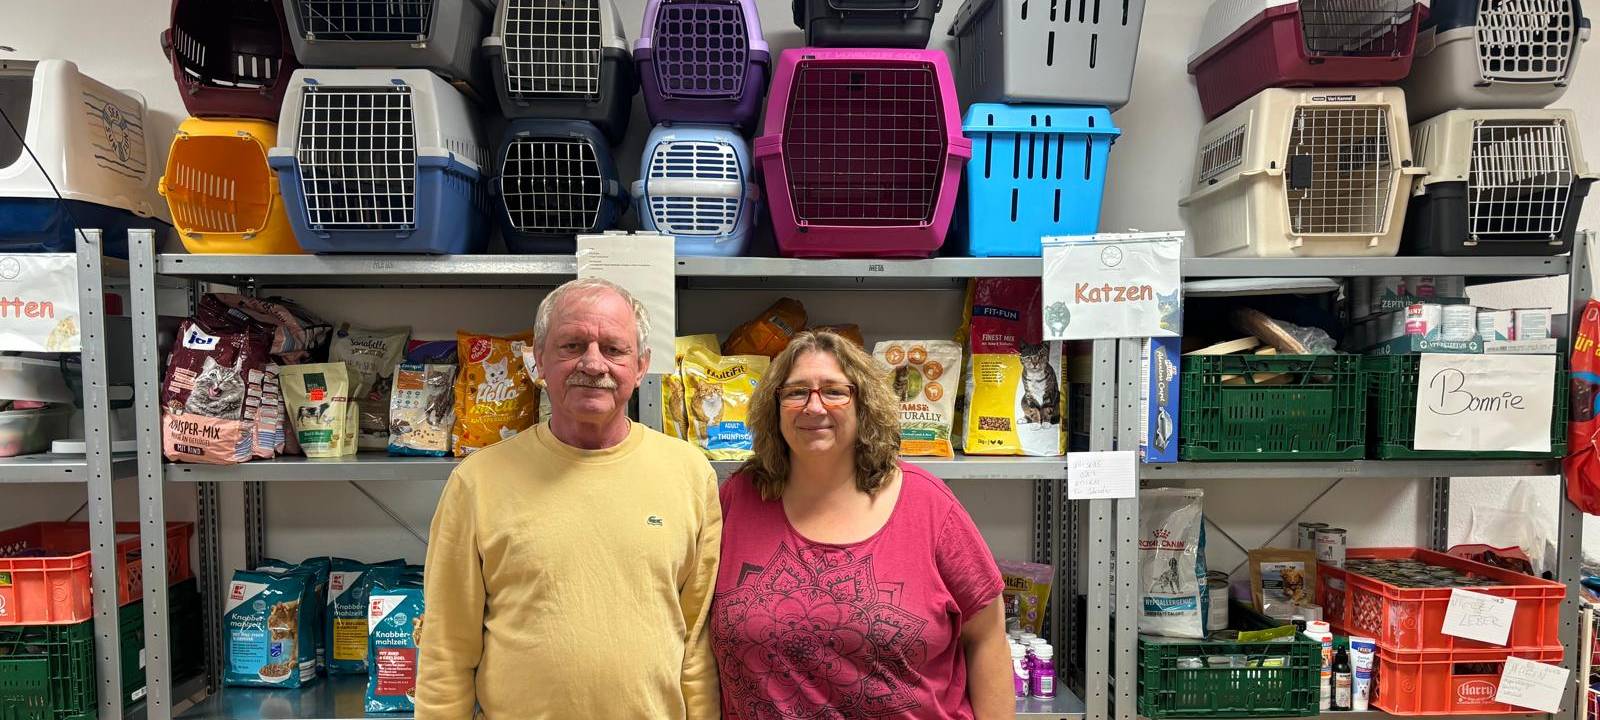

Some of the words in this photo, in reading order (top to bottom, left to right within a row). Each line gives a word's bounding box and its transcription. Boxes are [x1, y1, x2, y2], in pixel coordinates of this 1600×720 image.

[1075, 282, 1153, 304] Katzen
[188, 331, 213, 345] ja!
[982, 333, 1003, 341] FINEST
[706, 365, 746, 379] MultiFit
[1429, 368, 1525, 415] Bonnie
[177, 444, 186, 453] MIT
[1161, 540, 1185, 548] CANIN
[231, 612, 266, 622] Knabber-
[375, 630, 411, 638] Knabber-
[1461, 683, 1493, 697] Harry
